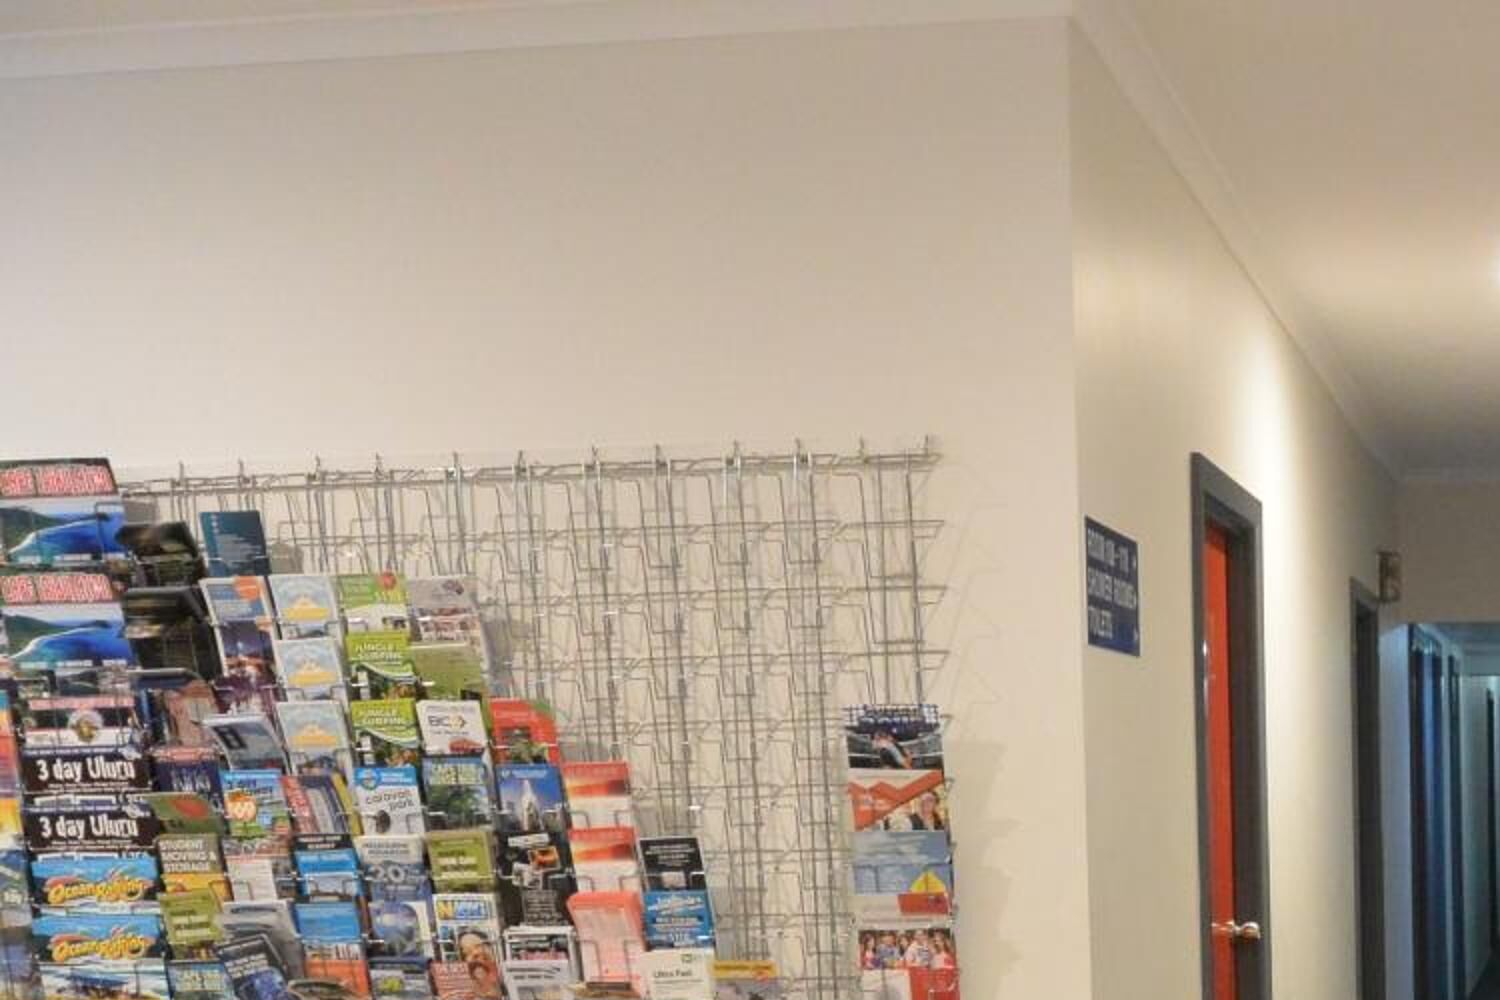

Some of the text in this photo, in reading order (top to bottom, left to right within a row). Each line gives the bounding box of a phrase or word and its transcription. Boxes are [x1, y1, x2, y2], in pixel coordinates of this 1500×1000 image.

[36, 756, 136, 782] 3 day Uluru
[39, 813, 139, 839] 3 day Uluru
